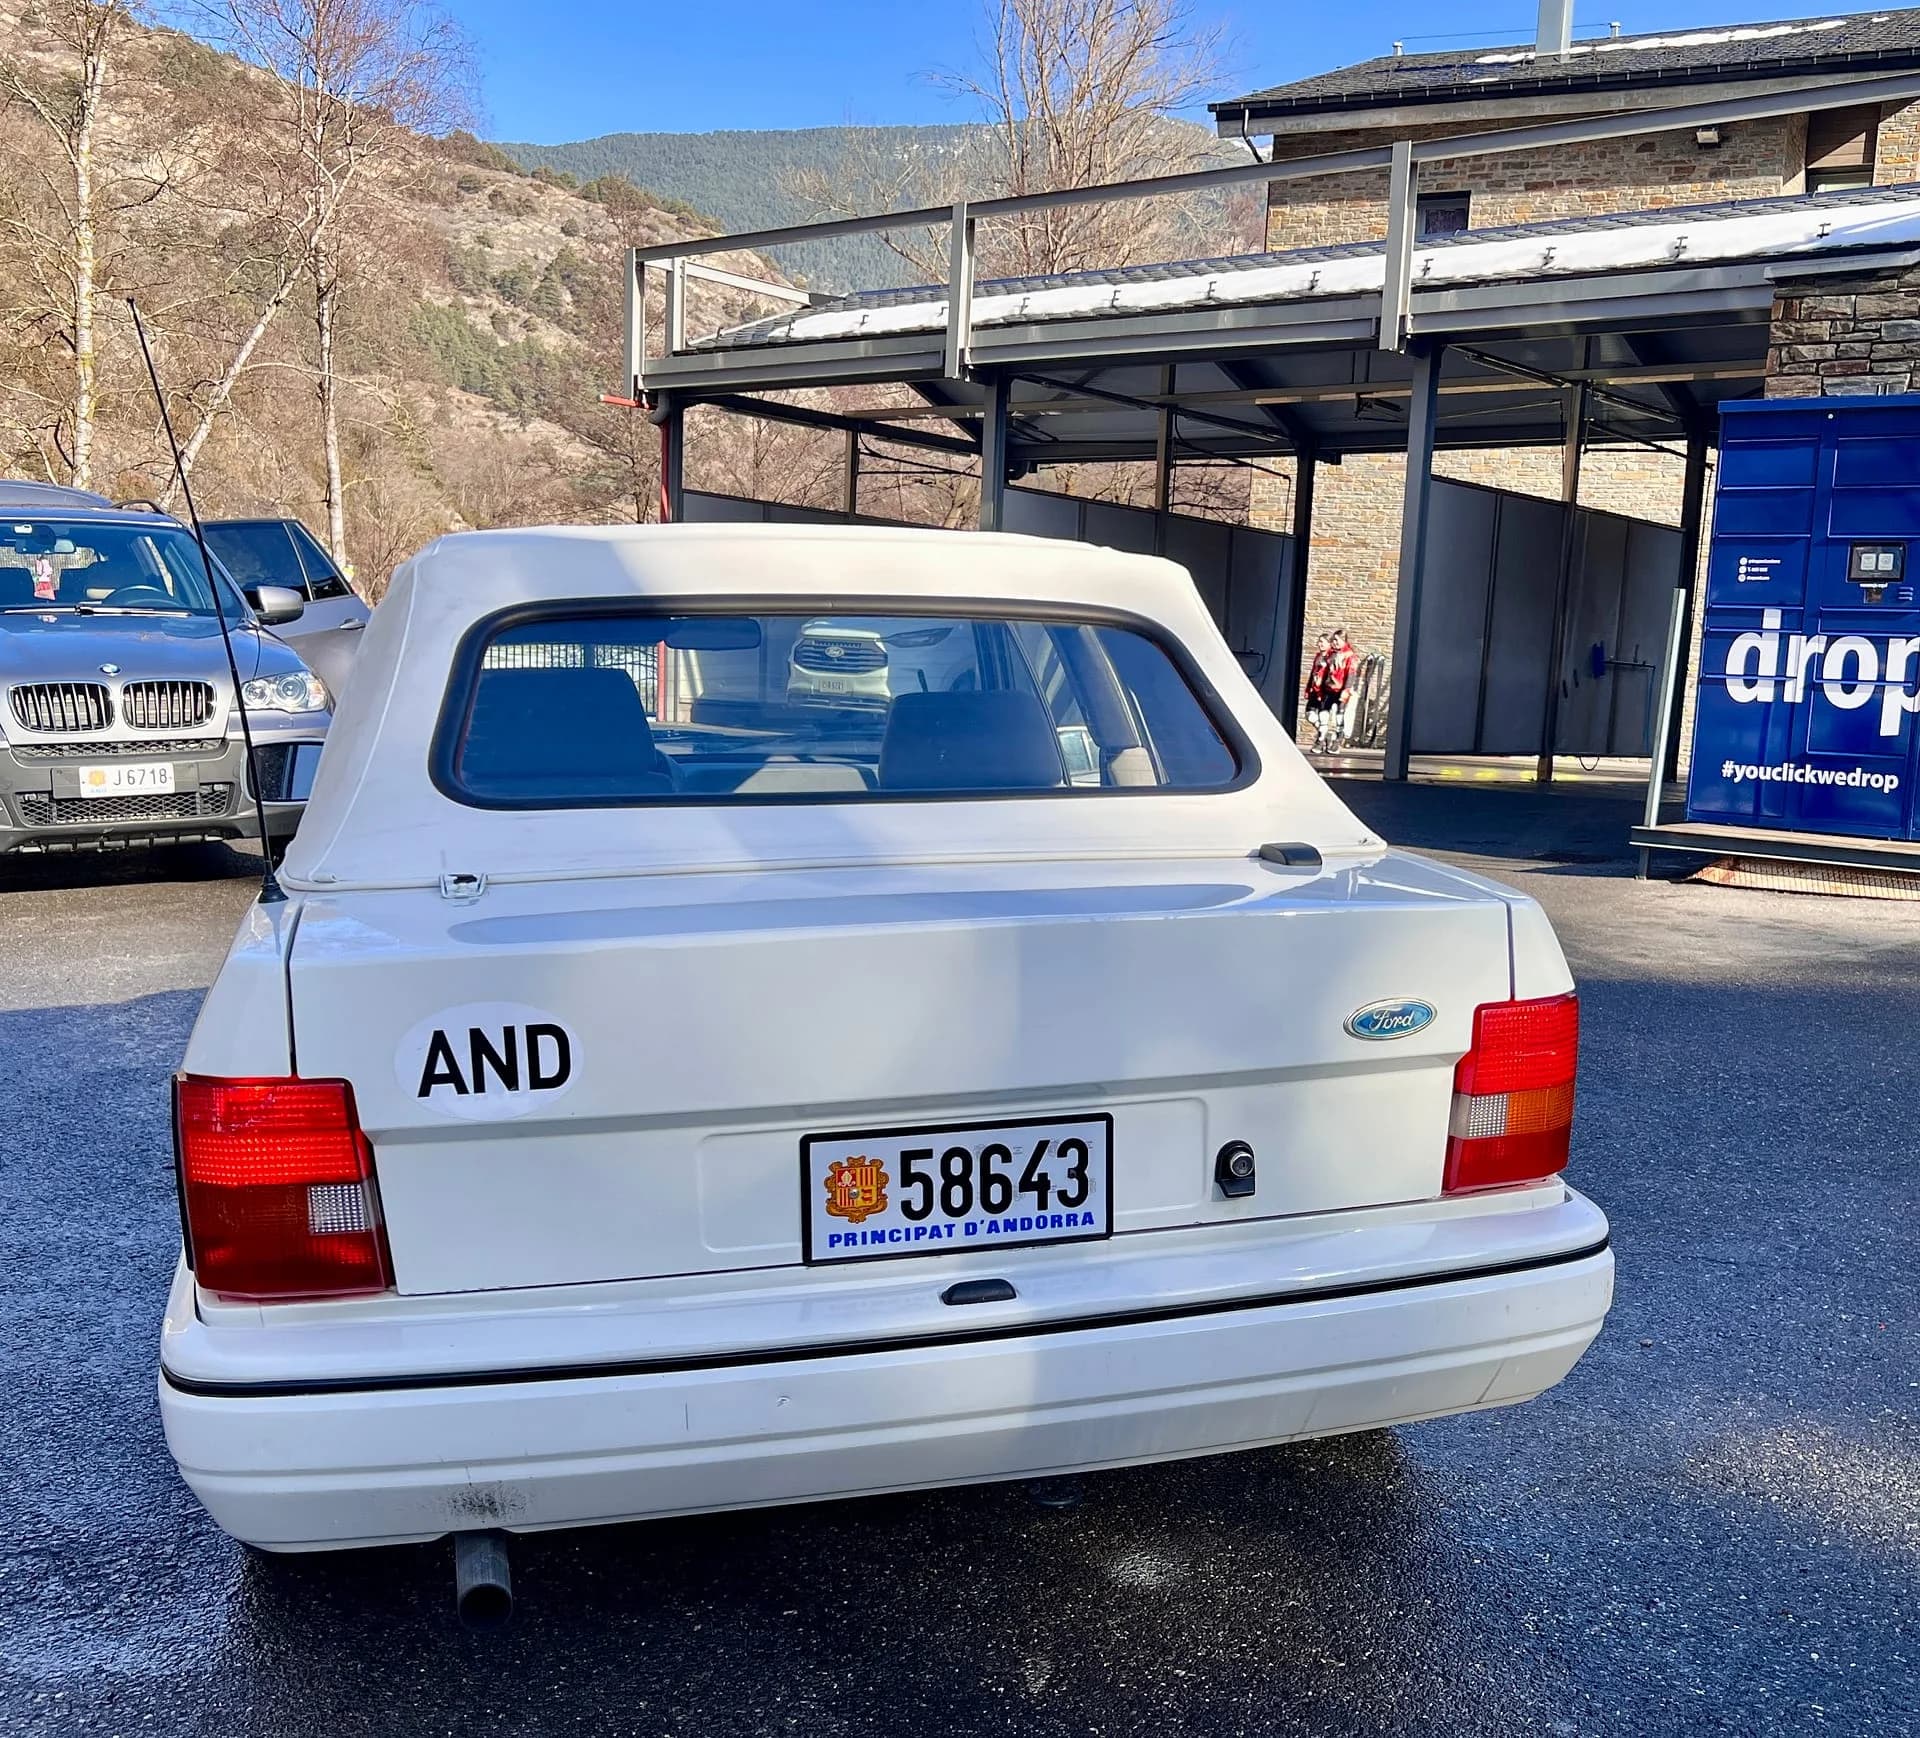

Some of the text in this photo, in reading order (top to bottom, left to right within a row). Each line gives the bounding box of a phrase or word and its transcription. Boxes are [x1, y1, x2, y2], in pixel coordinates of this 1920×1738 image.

[1721, 760, 1899, 794] #youclickwedrop
[1368, 1007, 1415, 1032] Ford
[417, 1023, 572, 1098] AND
[900, 1137, 1089, 1222] 58643
[828, 1210, 1095, 1248] PRINCIPAT D'ANDORRA
